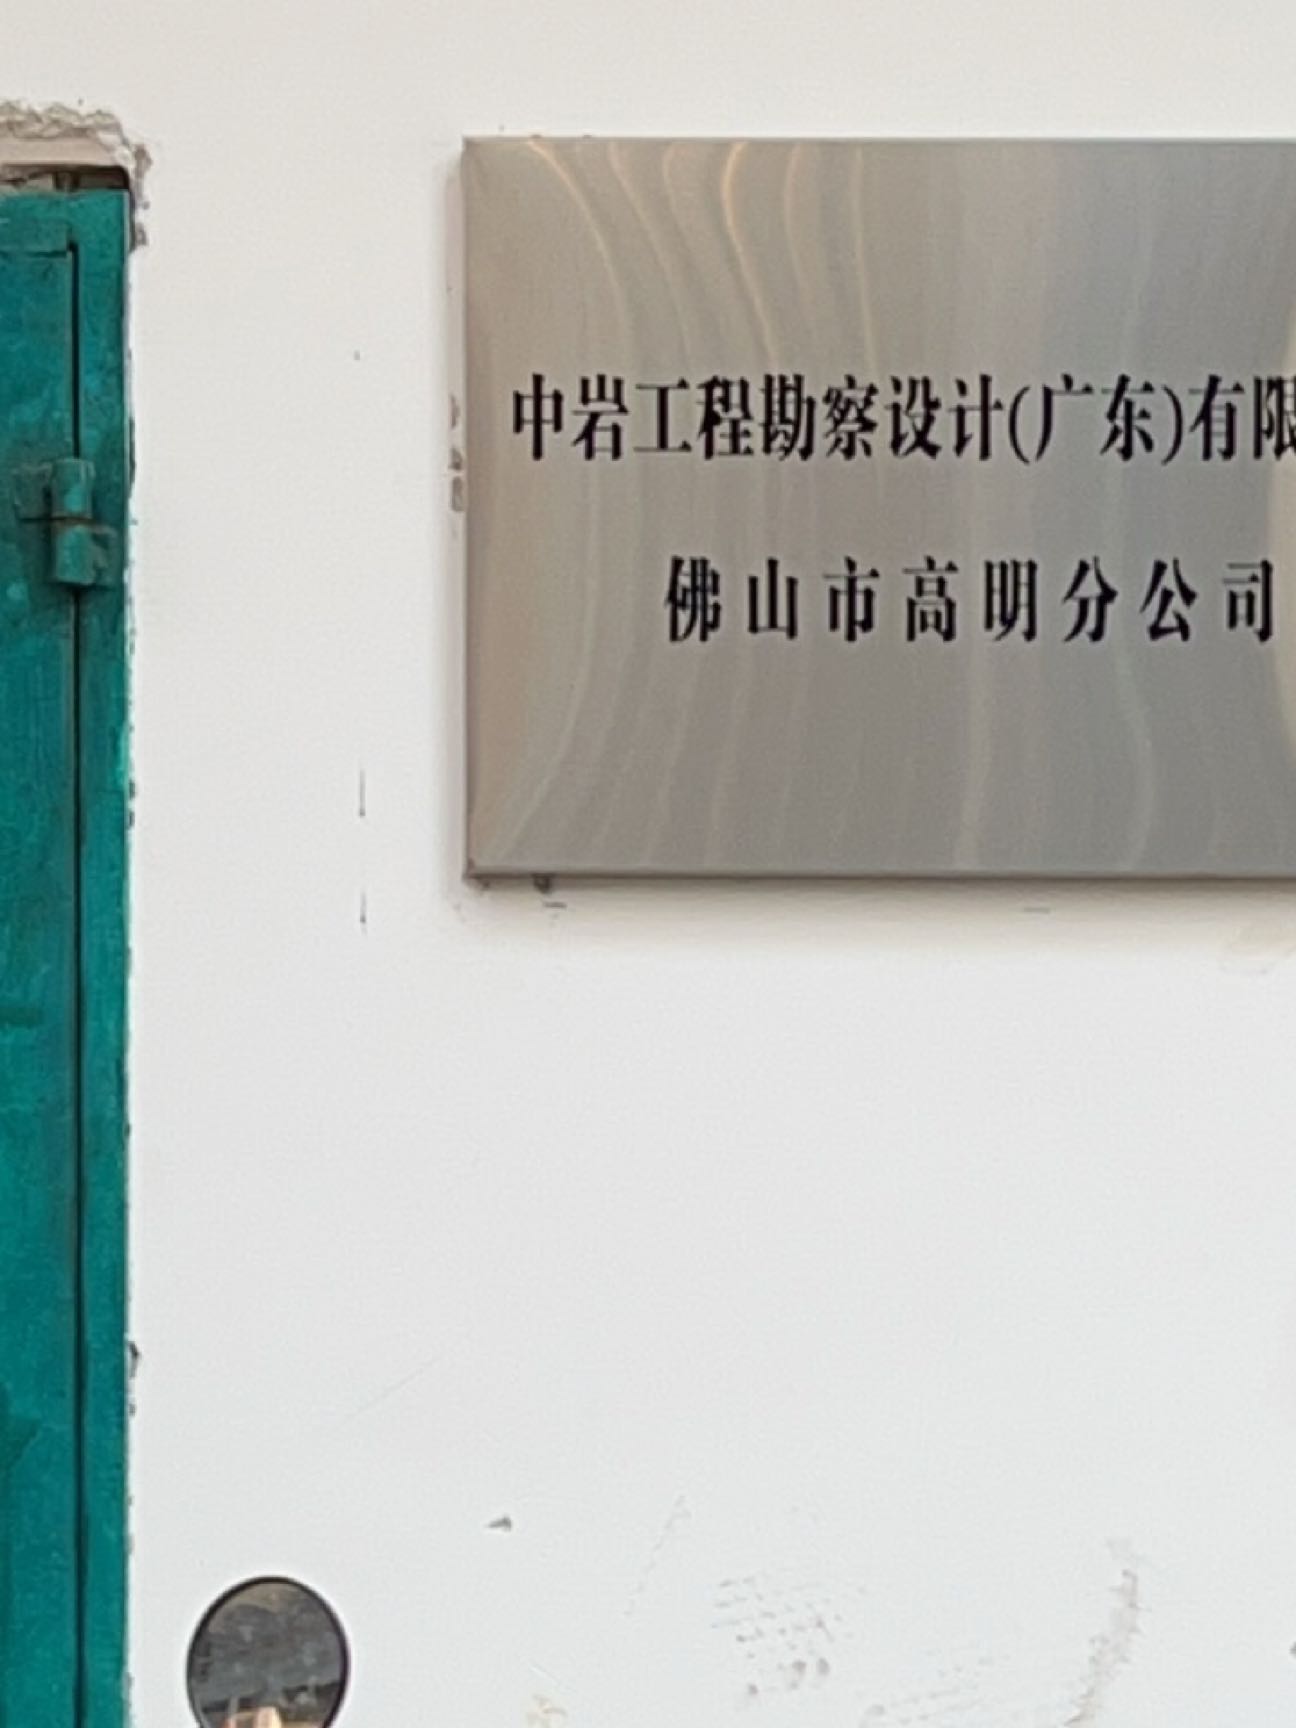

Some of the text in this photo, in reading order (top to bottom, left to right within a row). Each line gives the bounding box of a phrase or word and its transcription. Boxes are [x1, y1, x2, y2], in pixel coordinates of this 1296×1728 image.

[665, 554, 1274, 643] 佛山市高明分公司
